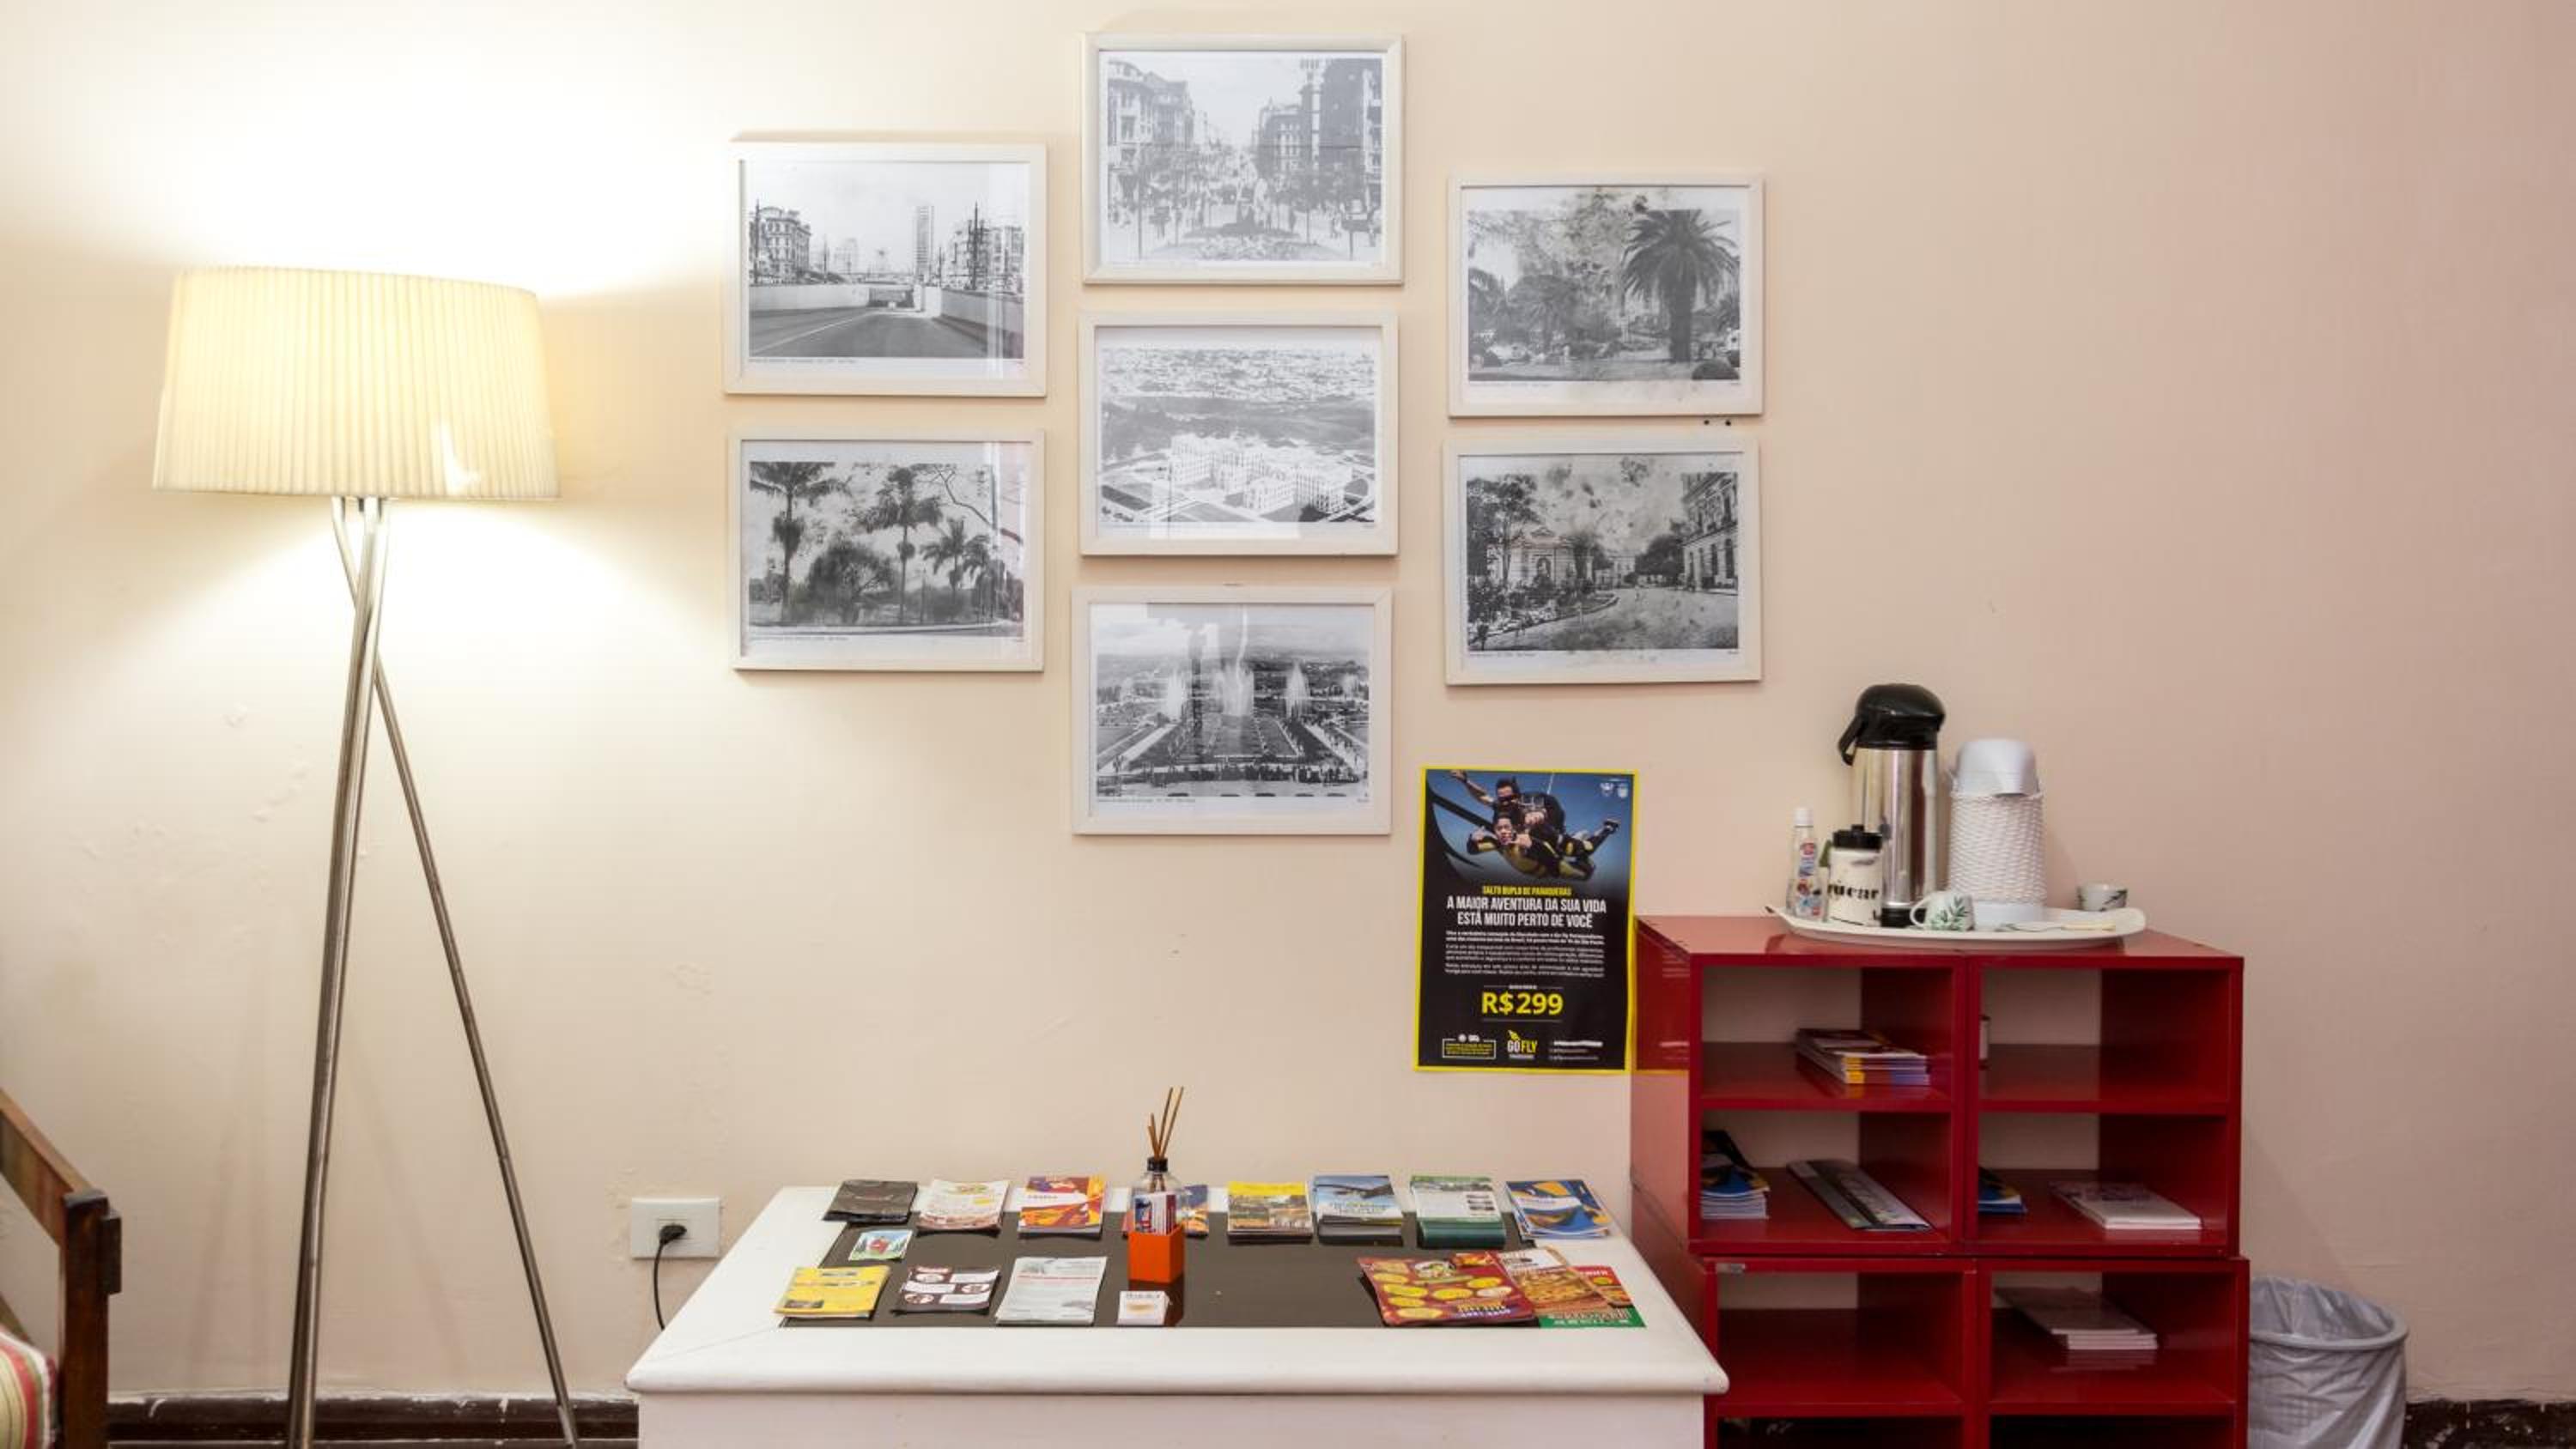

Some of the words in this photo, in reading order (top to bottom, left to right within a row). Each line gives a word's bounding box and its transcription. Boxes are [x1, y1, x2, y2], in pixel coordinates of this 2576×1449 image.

[1447, 895, 1455, 909] A
[1456, 895, 1489, 910] MAIOR
[1491, 897, 1543, 911] AVENTURA
[1545, 898, 1558, 911] DA
[1560, 898, 1581, 912] SUA
[1582, 899, 1607, 913] VIDA
[1457, 909, 1482, 925] ESTÁ
[1484, 912, 1516, 925] MUITO
[1517, 912, 1549, 926] PERTO
[1551, 913, 1564, 926] DE
[1565, 912, 1593, 928] VOCÊ
